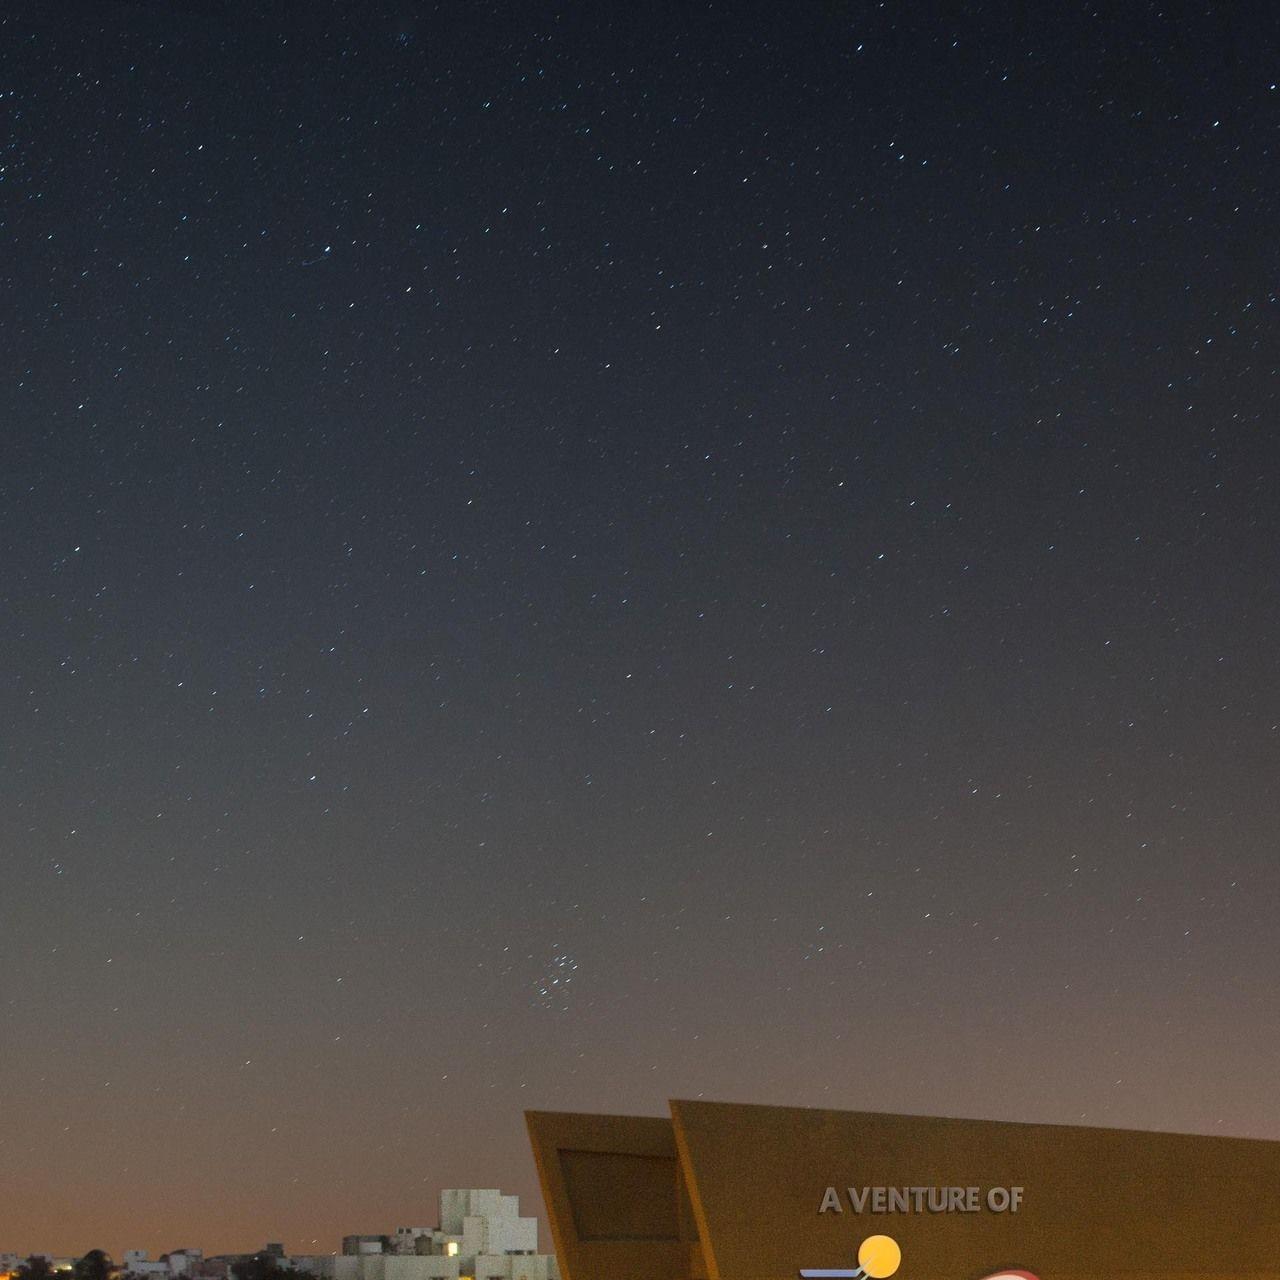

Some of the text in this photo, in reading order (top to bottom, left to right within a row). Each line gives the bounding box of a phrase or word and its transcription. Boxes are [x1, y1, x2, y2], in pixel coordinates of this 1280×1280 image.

[818, 1186, 1025, 1214] A VENTURE OF
